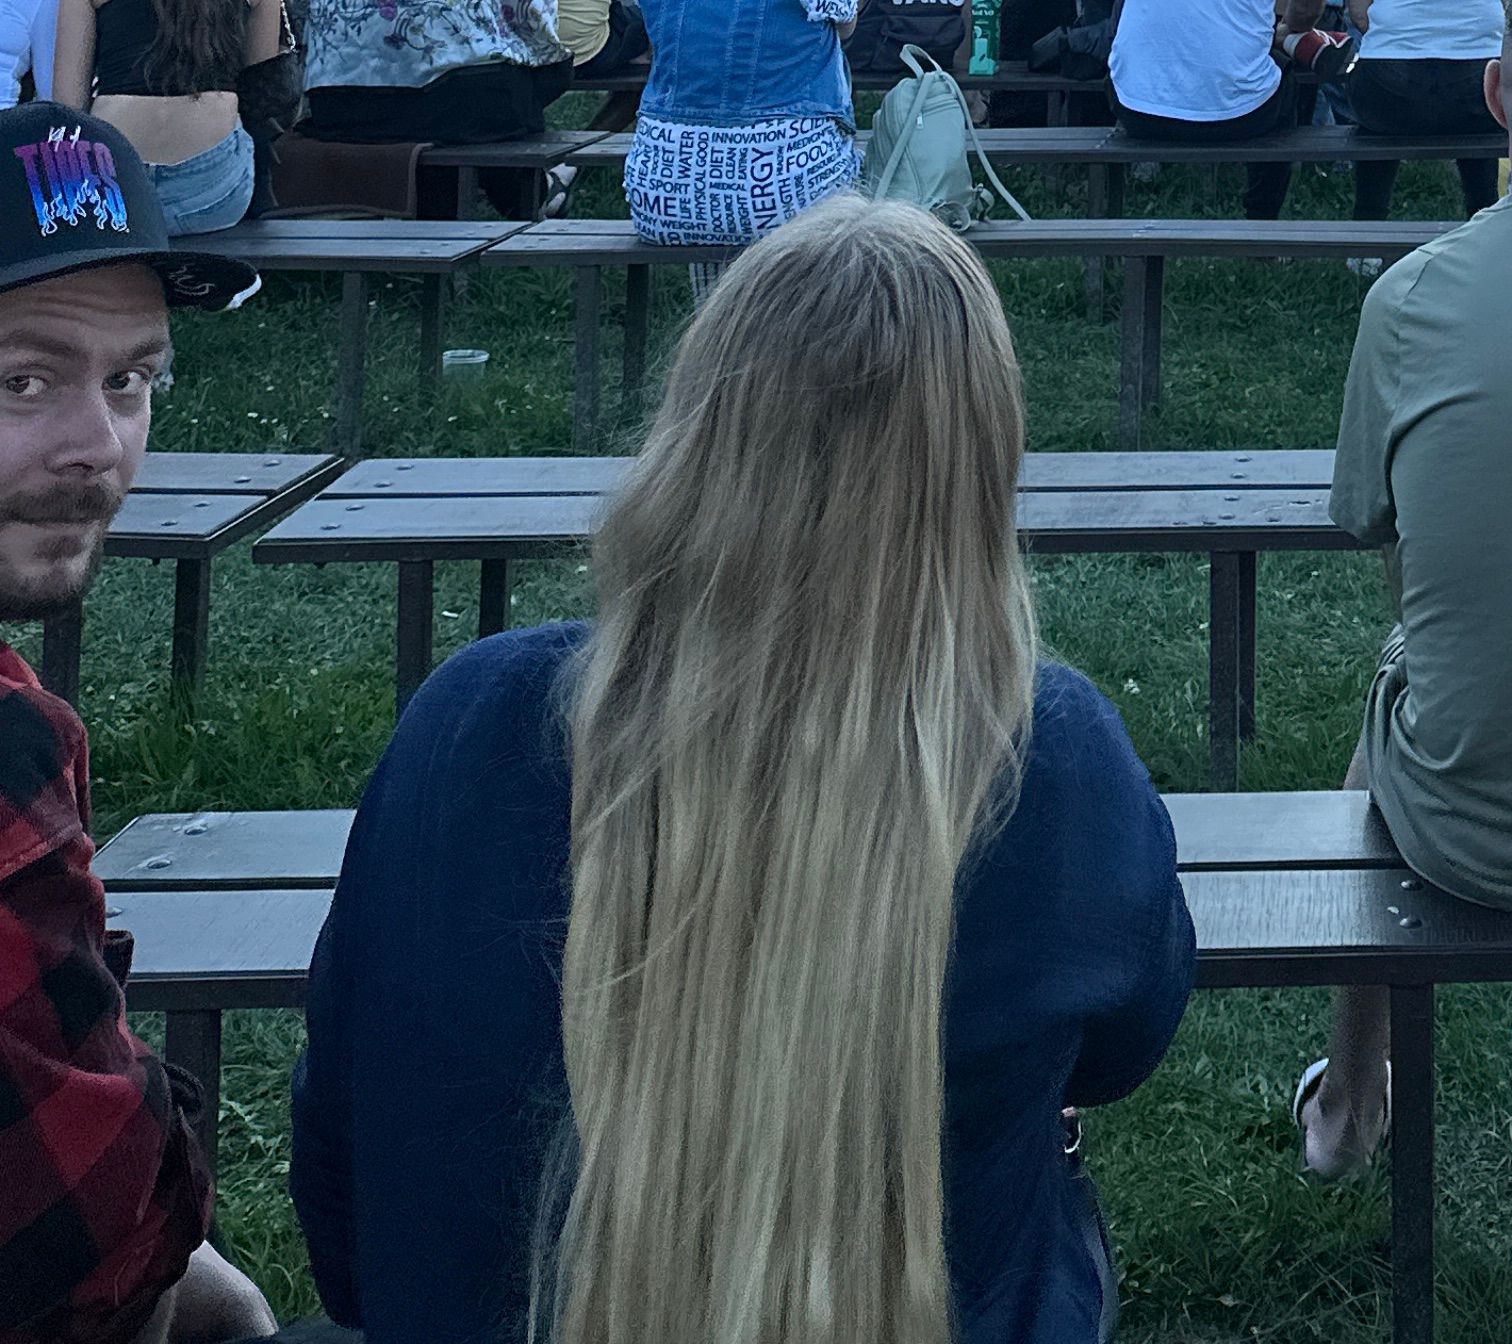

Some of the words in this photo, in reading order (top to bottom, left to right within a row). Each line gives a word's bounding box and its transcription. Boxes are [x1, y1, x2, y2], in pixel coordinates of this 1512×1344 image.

[696, 131, 709, 168] GOOD
[711, 128, 786, 145] INNOVATION
[660, 145, 675, 179] DIET
[677, 129, 695, 180] WATER
[709, 146, 725, 179] DIET
[725, 147, 738, 180] CLEAN
[648, 178, 691, 195] SPORT
[693, 169, 709, 221] PHYSICAL
[750, 147, 782, 231] NERGY
[680, 197, 692, 220] LIFE
[709, 193, 725, 234] DOCTOR
[659, 219, 708, 232] WEIGHT
